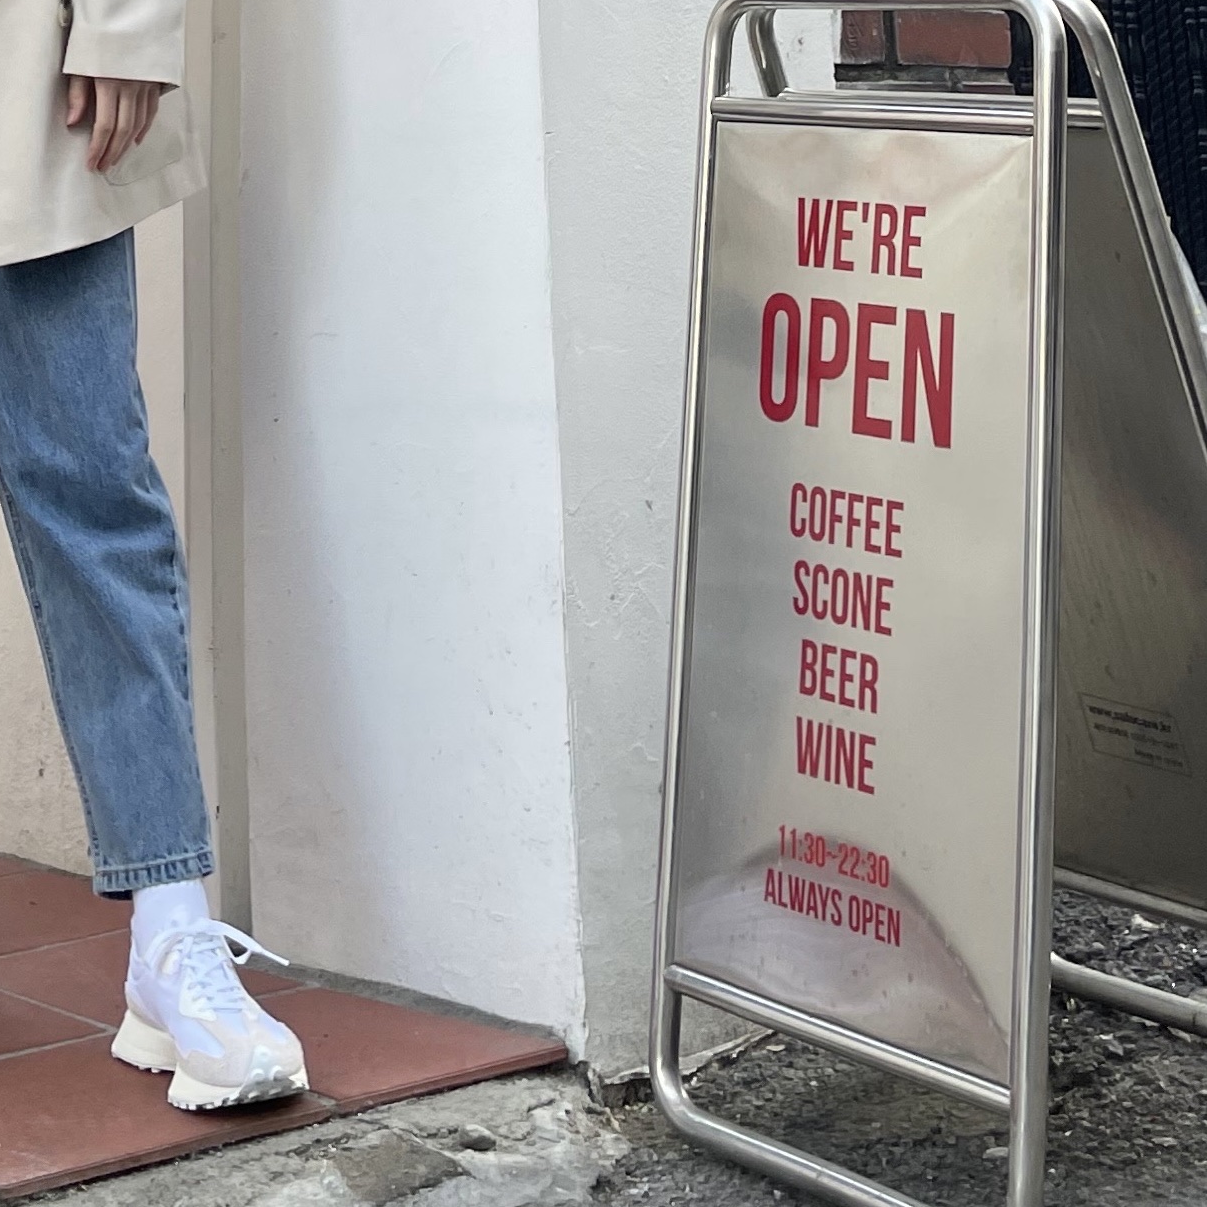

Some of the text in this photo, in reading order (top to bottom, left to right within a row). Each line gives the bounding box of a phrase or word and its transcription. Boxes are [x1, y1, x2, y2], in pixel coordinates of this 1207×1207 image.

[797, 196, 926, 279] WE'RE
[759, 292, 955, 449] OPEN
[789, 482, 905, 559] COFFEE
[792, 559, 894, 637] SCONE
[799, 639, 880, 715] BEER
[796, 716, 876, 796] WINE
[763, 868, 901, 948] ALWAYS OPEN
